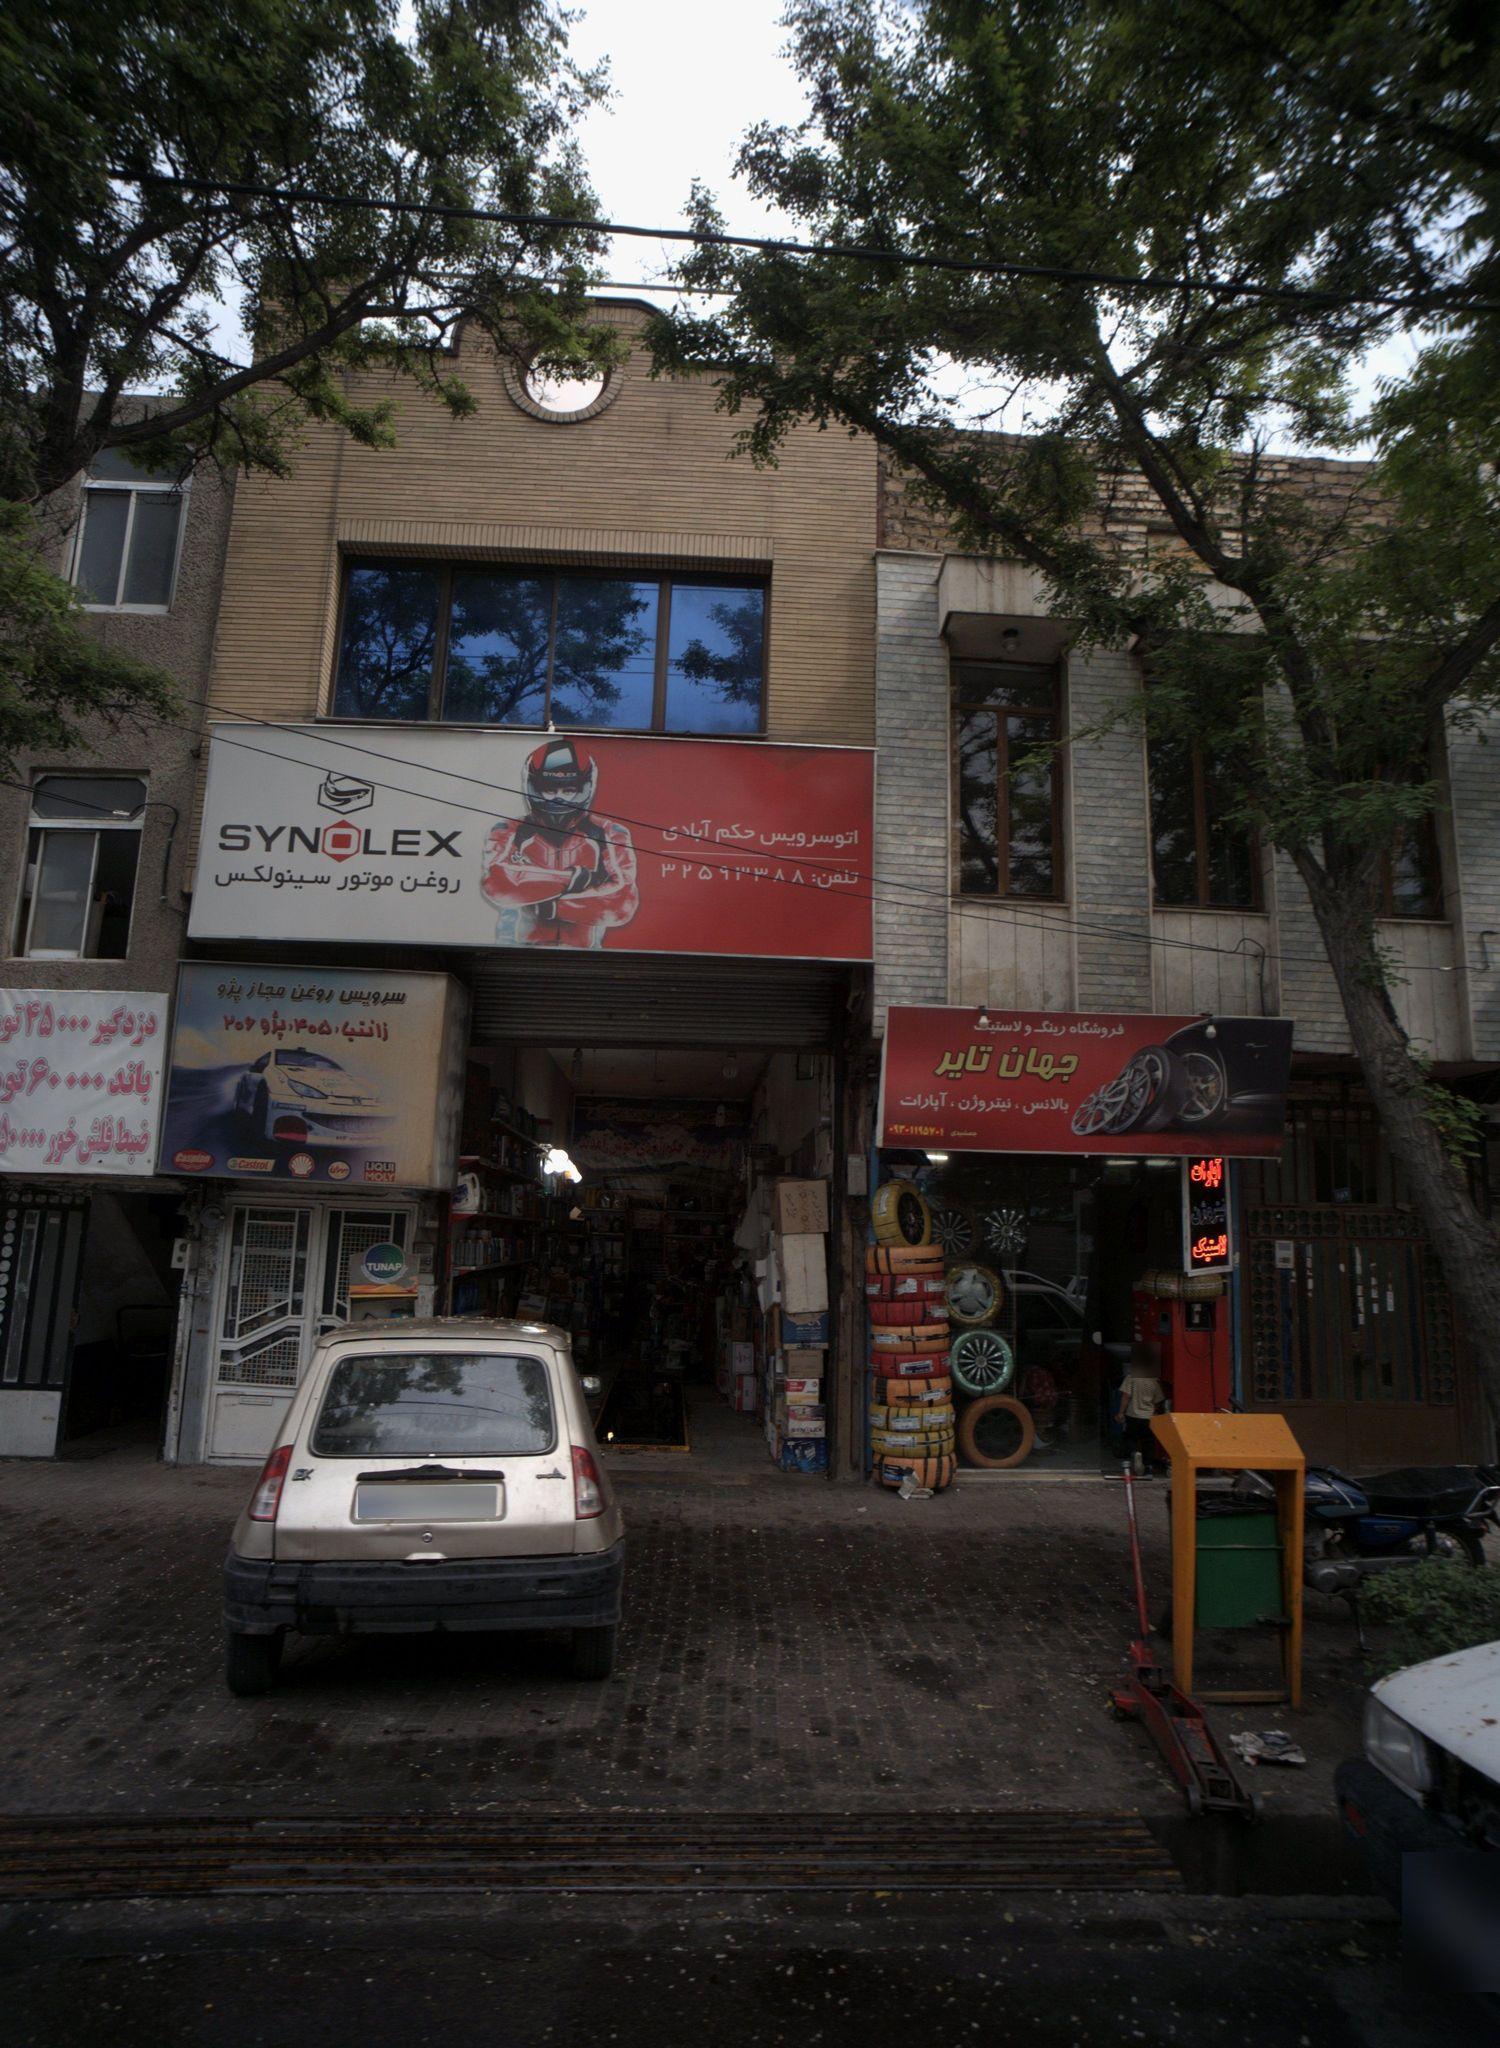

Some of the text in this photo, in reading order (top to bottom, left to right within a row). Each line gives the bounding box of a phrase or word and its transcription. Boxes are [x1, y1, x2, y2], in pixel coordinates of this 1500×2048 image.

[218, 821, 463, 861] SYNOLEX
[662, 820, 712, 842] آبادی
[716, 823, 756, 841] حکم
[214, 865, 462, 894] روغن موتور سینولکس
[811, 868, 859, 888] تلفن:
[217, 978, 407, 1007] سرویس روغن مجاز پژو
[25, 1000, 90, 1038] ۴۵۰۰۰
[90, 1006, 158, 1045] دزدگیر
[223, 1014, 256, 1032] ۲۰۶
[260, 1010, 287, 1041] پژو
[1024, 1023, 1033, 1037] و
[1033, 1020, 1066, 1036] رینگ
[1068, 1021, 1125, 1039] فروشگاه
[934, 1044, 1079, 1083] جهان تایر
[108, 1060, 154, 1104] باند
[899, 1091, 948, 1113] آپارات
[43, 1116, 79, 1165] خور
[77, 1115, 115, 1165] فلش
[114, 1117, 151, 1165] ضبط
[238, 1159, 270, 1170] Castrol
[367, 1262, 402, 1271] TUNAP
